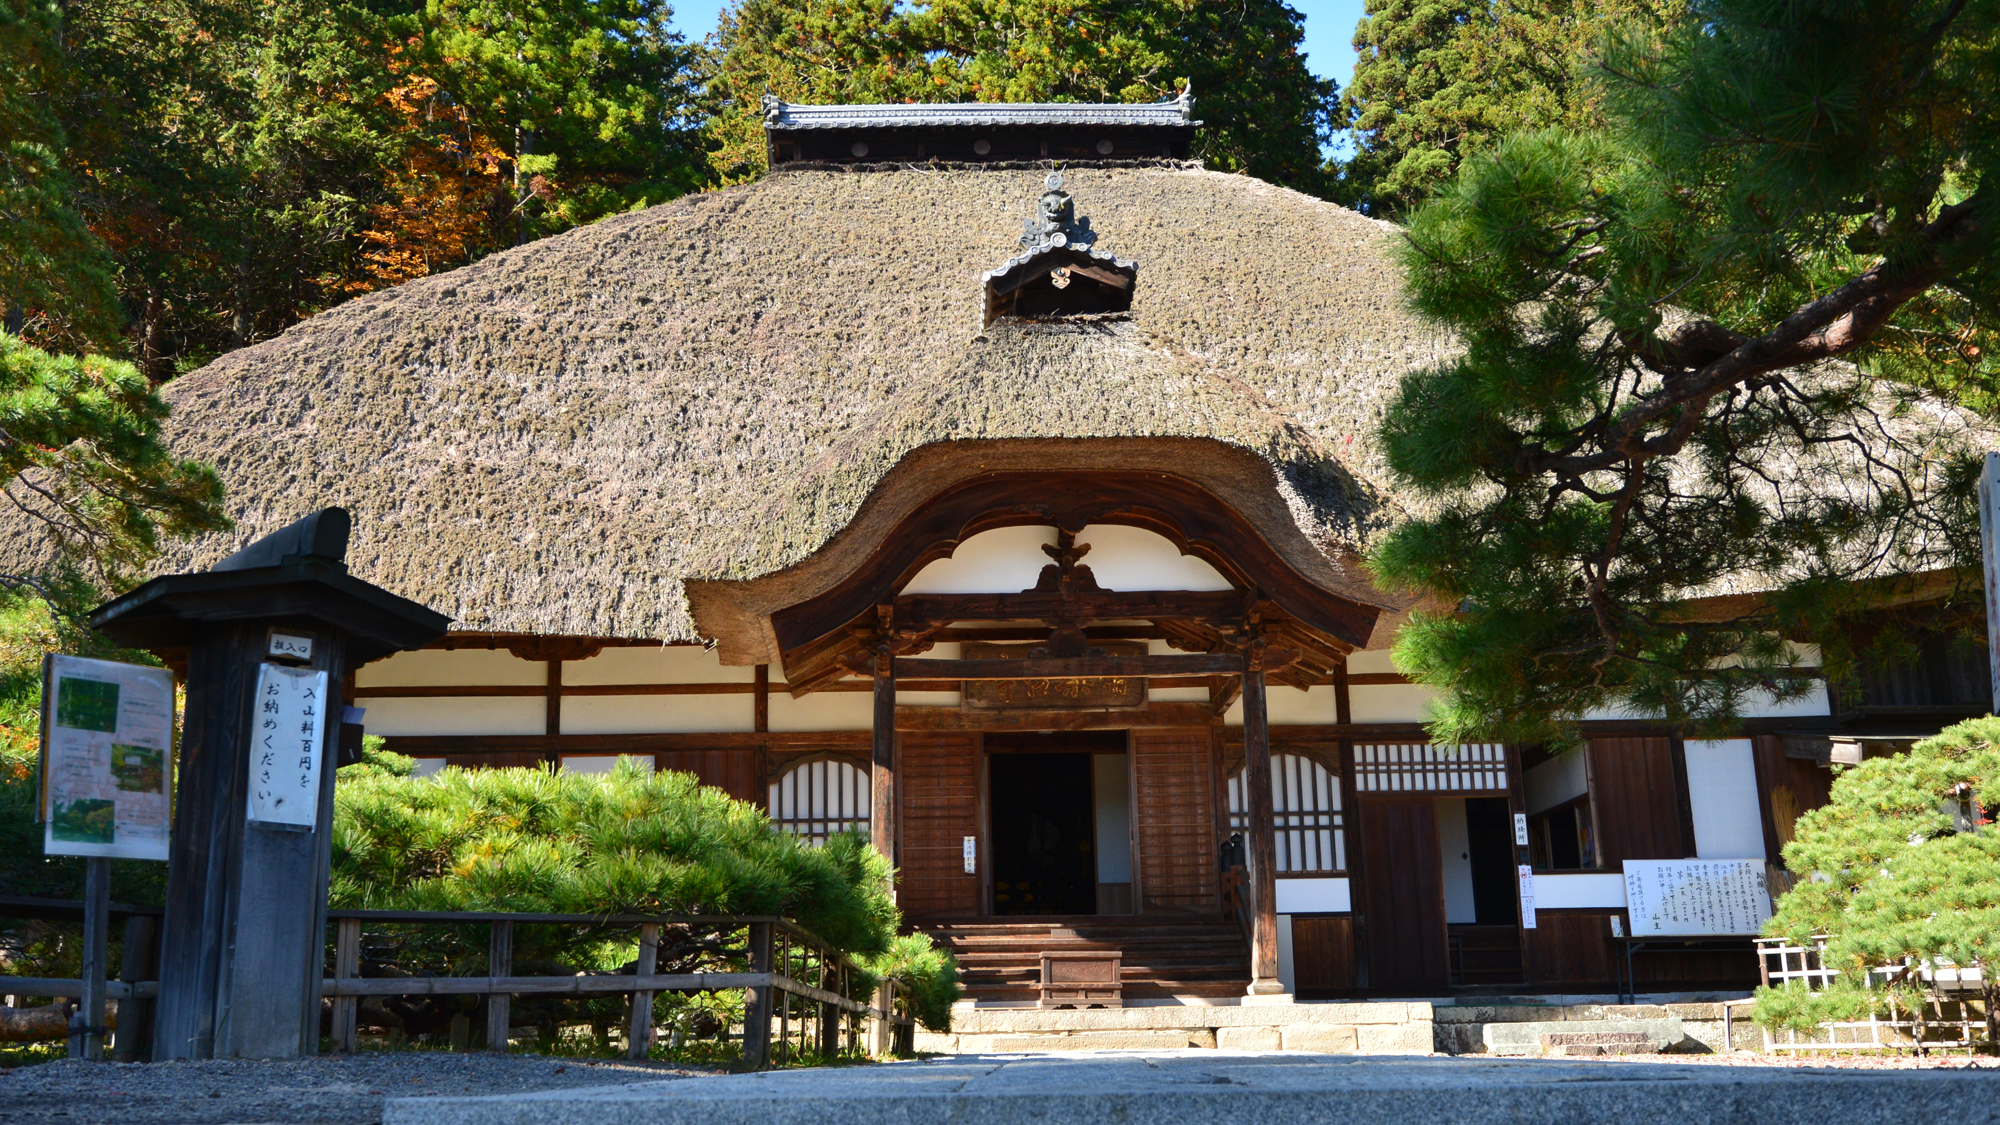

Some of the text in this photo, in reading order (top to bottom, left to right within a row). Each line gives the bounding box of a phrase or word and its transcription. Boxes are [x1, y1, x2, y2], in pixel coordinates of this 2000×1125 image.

[274, 639, 308, 653] 投入口
[258, 683, 280, 800] お納めください
[299, 687, 316, 788] 入山料百円を
[1516, 816, 1526, 843] 納経所
[1657, 866, 1669, 920] お願い申し上げます
[1686, 865, 1698, 919] お願い申し上げます
[1756, 871, 1766, 896] お願い
[1652, 913, 1661, 930] 山主
